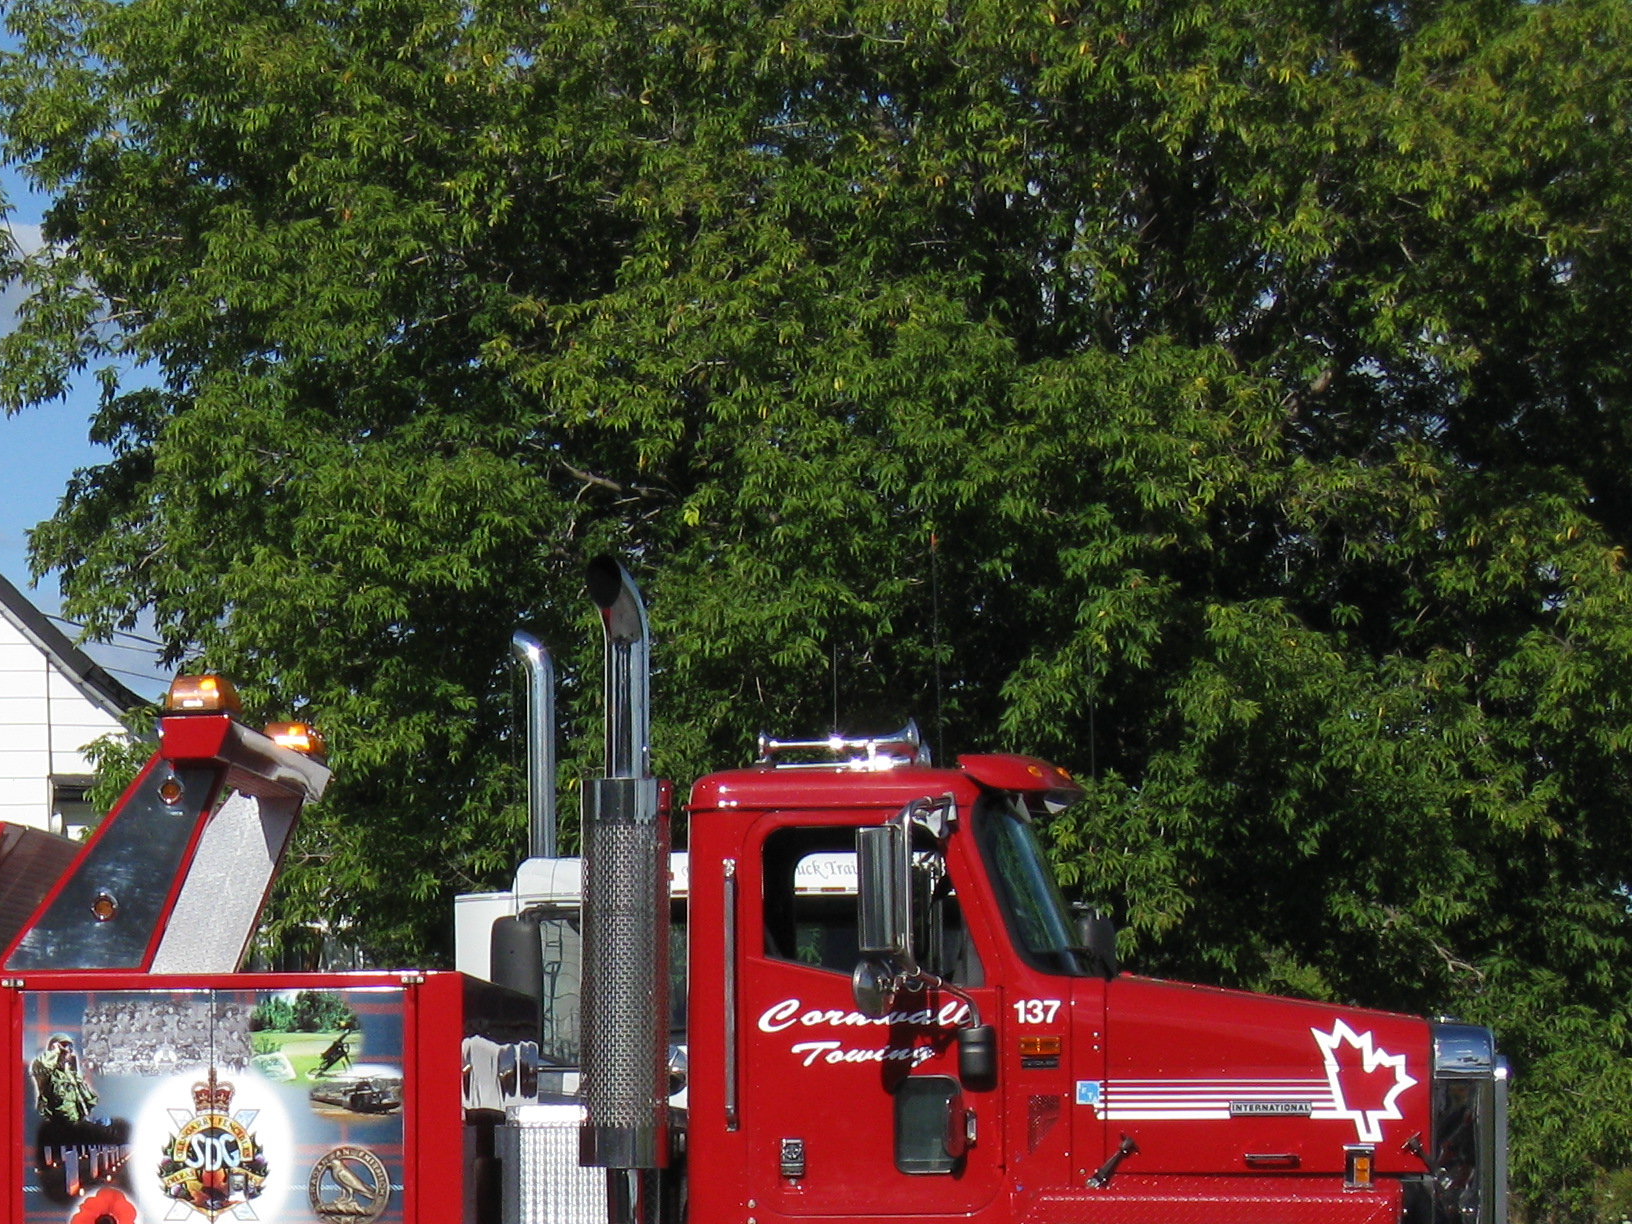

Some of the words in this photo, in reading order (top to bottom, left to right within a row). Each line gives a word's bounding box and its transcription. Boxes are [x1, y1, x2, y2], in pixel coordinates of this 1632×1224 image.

[757, 998, 972, 1033] Cornwall
[1013, 999, 1061, 1024] 137
[791, 1041, 936, 1068] Towing
[185, 1133, 241, 1171] SDG
